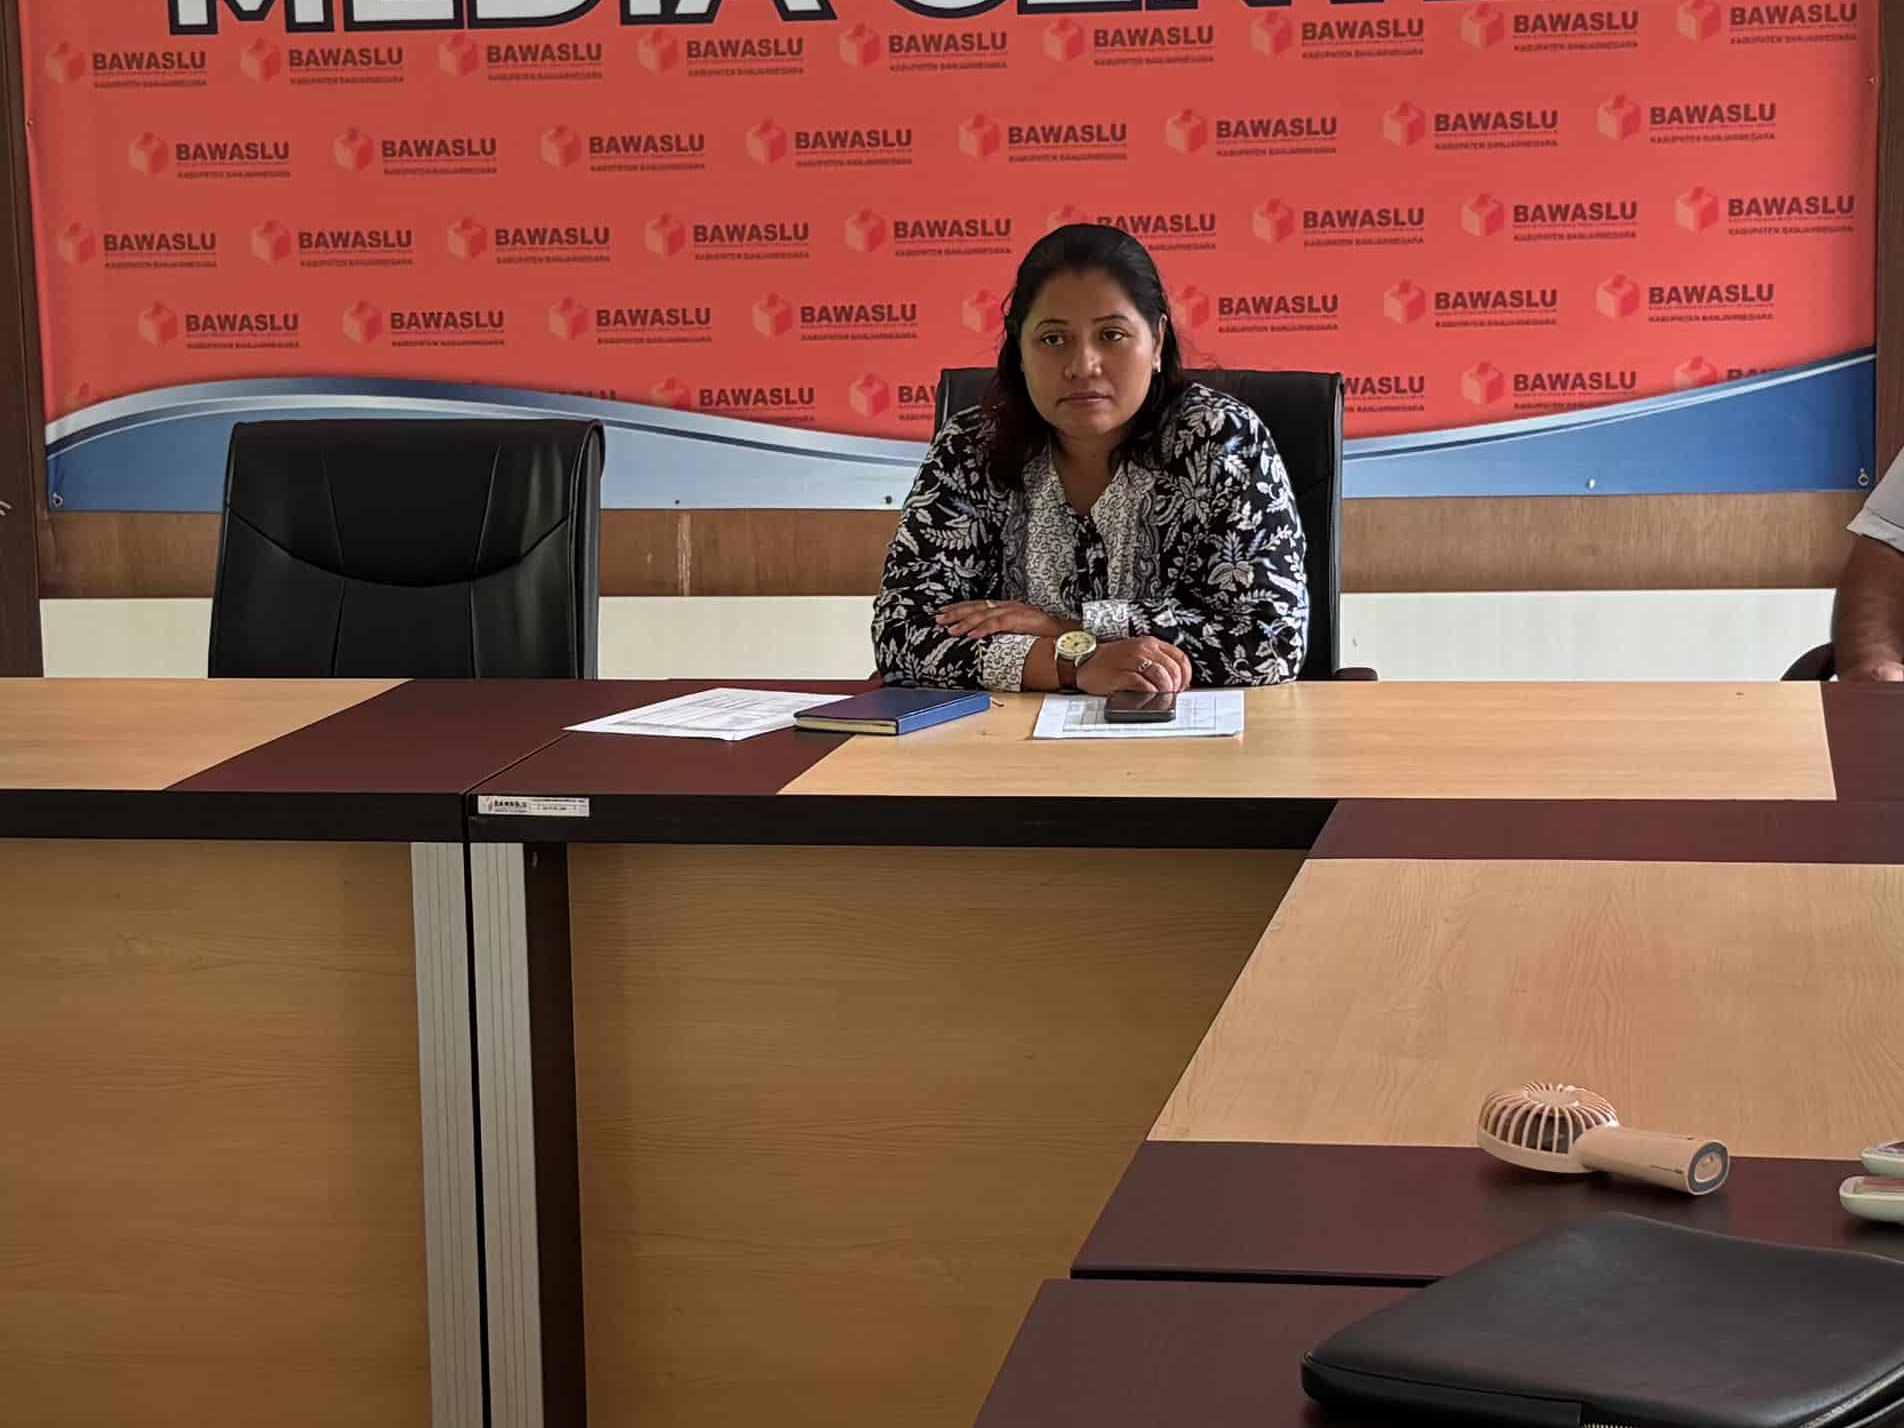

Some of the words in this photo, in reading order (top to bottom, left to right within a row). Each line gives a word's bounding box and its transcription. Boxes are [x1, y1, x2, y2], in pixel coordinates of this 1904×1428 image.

[1513, 11, 1639, 34] BAWASLU
[1730, 3, 1857, 26] BAWASLU
[1093, 26, 1214, 48] BAWASLU
[1302, 18, 1424, 41] BAWASLU
[487, 43, 602, 64] BAWASLU
[686, 38, 804, 59] BAWASLU
[888, 32, 1008, 54] BAWASLU
[93, 51, 206, 71] BAWASLU
[288, 47, 403, 67] BAWASLU
[1434, 109, 1558, 133] BAWASLU
[1650, 103, 1777, 125] BAWASLU
[1008, 123, 1127, 145] BAWASLU
[1216, 117, 1337, 139] BAWASLU
[382, 138, 497, 158] BAWASLU
[589, 134, 705, 154] BAWASLU
[795, 129, 912, 150] BAWASLU
[175, 141, 290, 161] BAWASLU
[1513, 202, 1638, 223] BAWASLU
[1728, 195, 1854, 217] BAWASLU
[894, 218, 1012, 239] BAWASLU
[1303, 207, 1425, 229] BAWASLU
[103, 233, 217, 252] BAWASLU
[298, 230, 412, 249] BAWASLU
[495, 227, 610, 247] BAWASLU
[693, 223, 809, 243] BAWASLU
[1434, 289, 1558, 311] BAWASLU
[1648, 283, 1774, 305] BAWASLU
[800, 303, 917, 324] BAWASLU
[1218, 294, 1339, 317] BAWASLU
[185, 314, 299, 333] BAWASLU
[390, 310, 504, 330] BAWASLU
[596, 307, 711, 327] BAWASLU
[1344, 375, 1425, 396] WASLU
[1513, 371, 1637, 392] BAWASLU
[699, 387, 815, 407] BAWASLU
